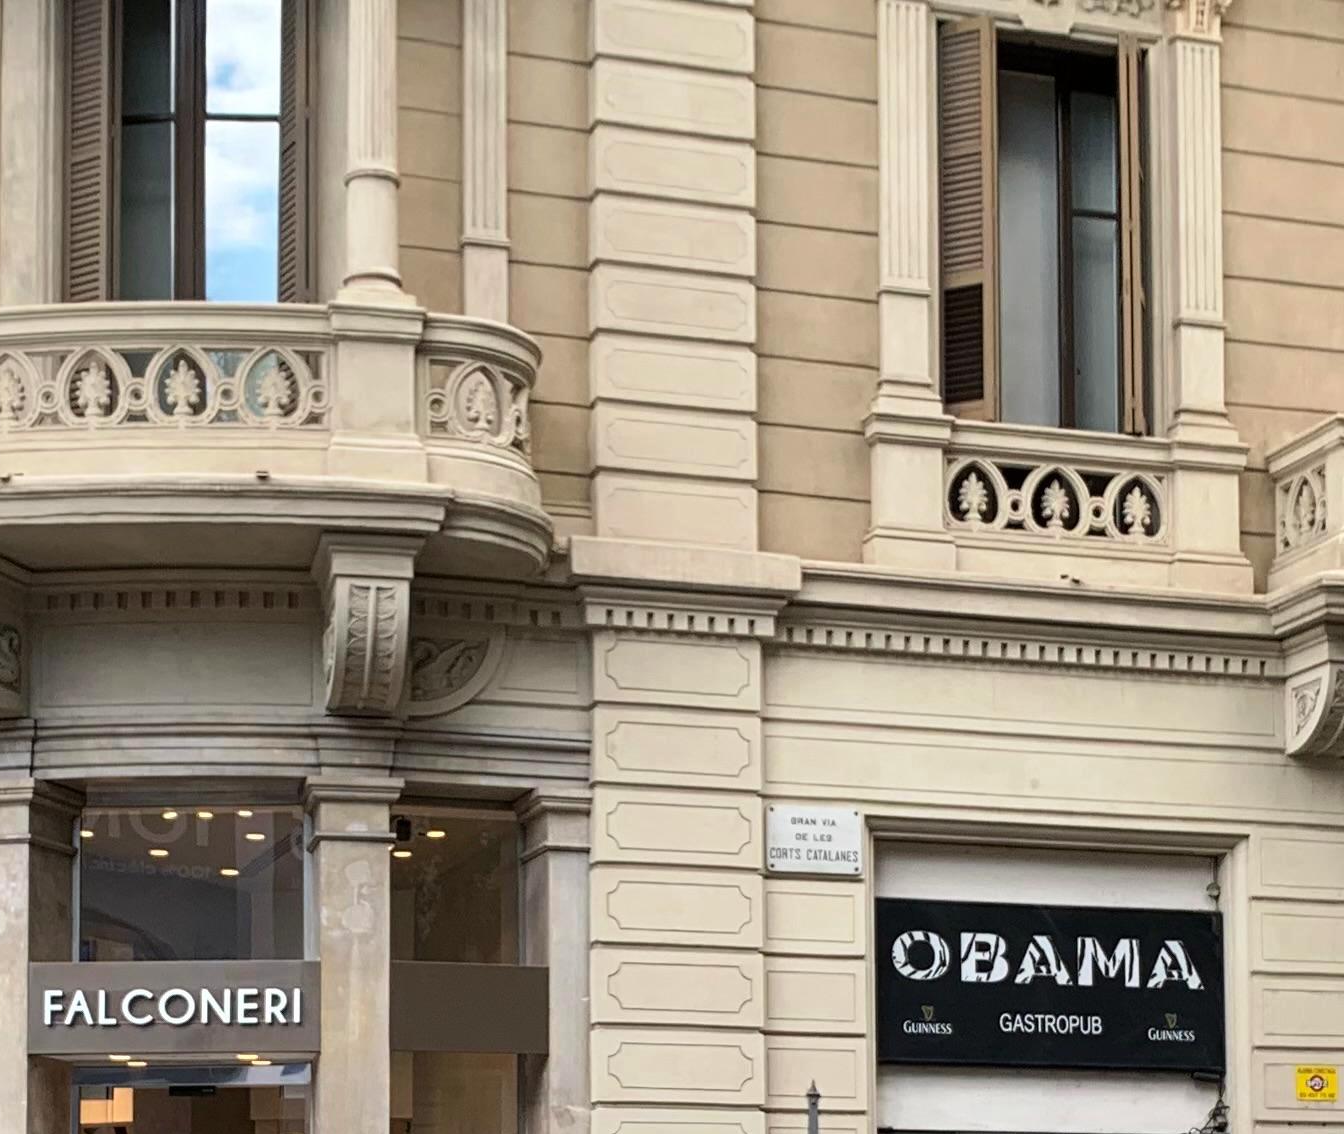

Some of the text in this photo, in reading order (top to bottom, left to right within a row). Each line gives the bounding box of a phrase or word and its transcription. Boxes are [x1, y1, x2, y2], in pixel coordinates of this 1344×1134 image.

[790, 817, 837, 827] GRAN VIA
[795, 832, 833, 842] DE LES
[769, 847, 859, 863] CORTS CATALANES
[891, 930, 1206, 990] OBAMA
[43, 988, 301, 1026] FALCONERI
[903, 1019, 952, 1034] GUINNESS
[999, 1012, 1103, 1035] GASTROPUB
[1147, 1026, 1195, 1042] GUINNESS
